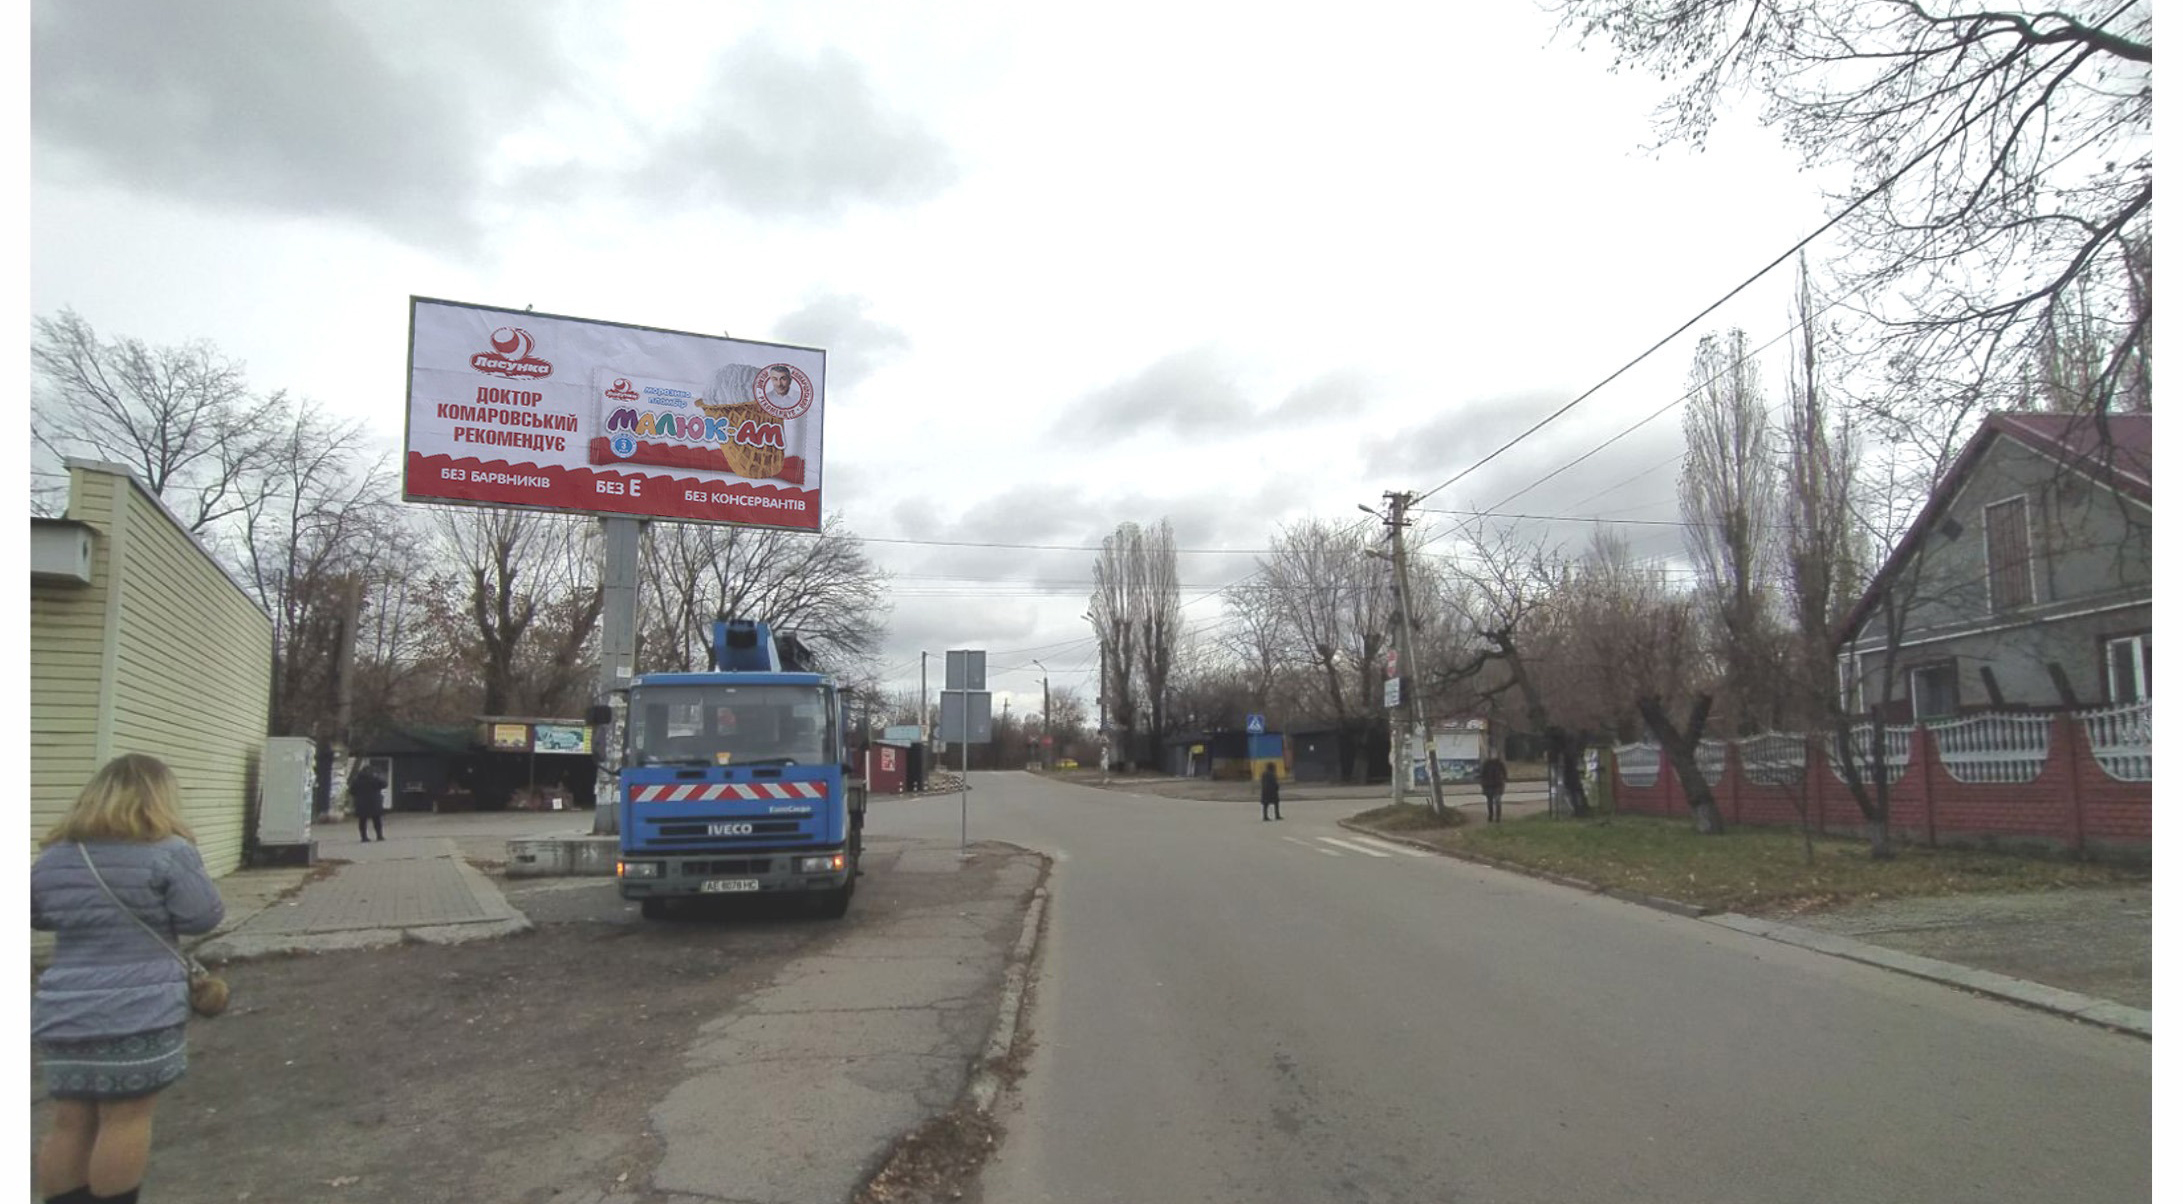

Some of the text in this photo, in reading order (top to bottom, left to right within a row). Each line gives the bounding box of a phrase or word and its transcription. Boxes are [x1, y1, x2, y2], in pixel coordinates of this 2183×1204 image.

[474, 356, 550, 374] Ласунка
[476, 386, 543, 407] ДОКТОР
[437, 403, 578, 432] КОМАРОВСЬКИЙ
[606, 407, 786, 449] МАЛЮК-АМ
[453, 426, 566, 452] РЕКОМЕНДУЄ
[441, 468, 550, 488] БЕЗ БАРВНИКІВ
[596, 480, 625, 495] БЕЗ
[685, 490, 806, 510] БЕЗ КОНСЕРВАНТІВ
[708, 824, 752, 835] IVECO
